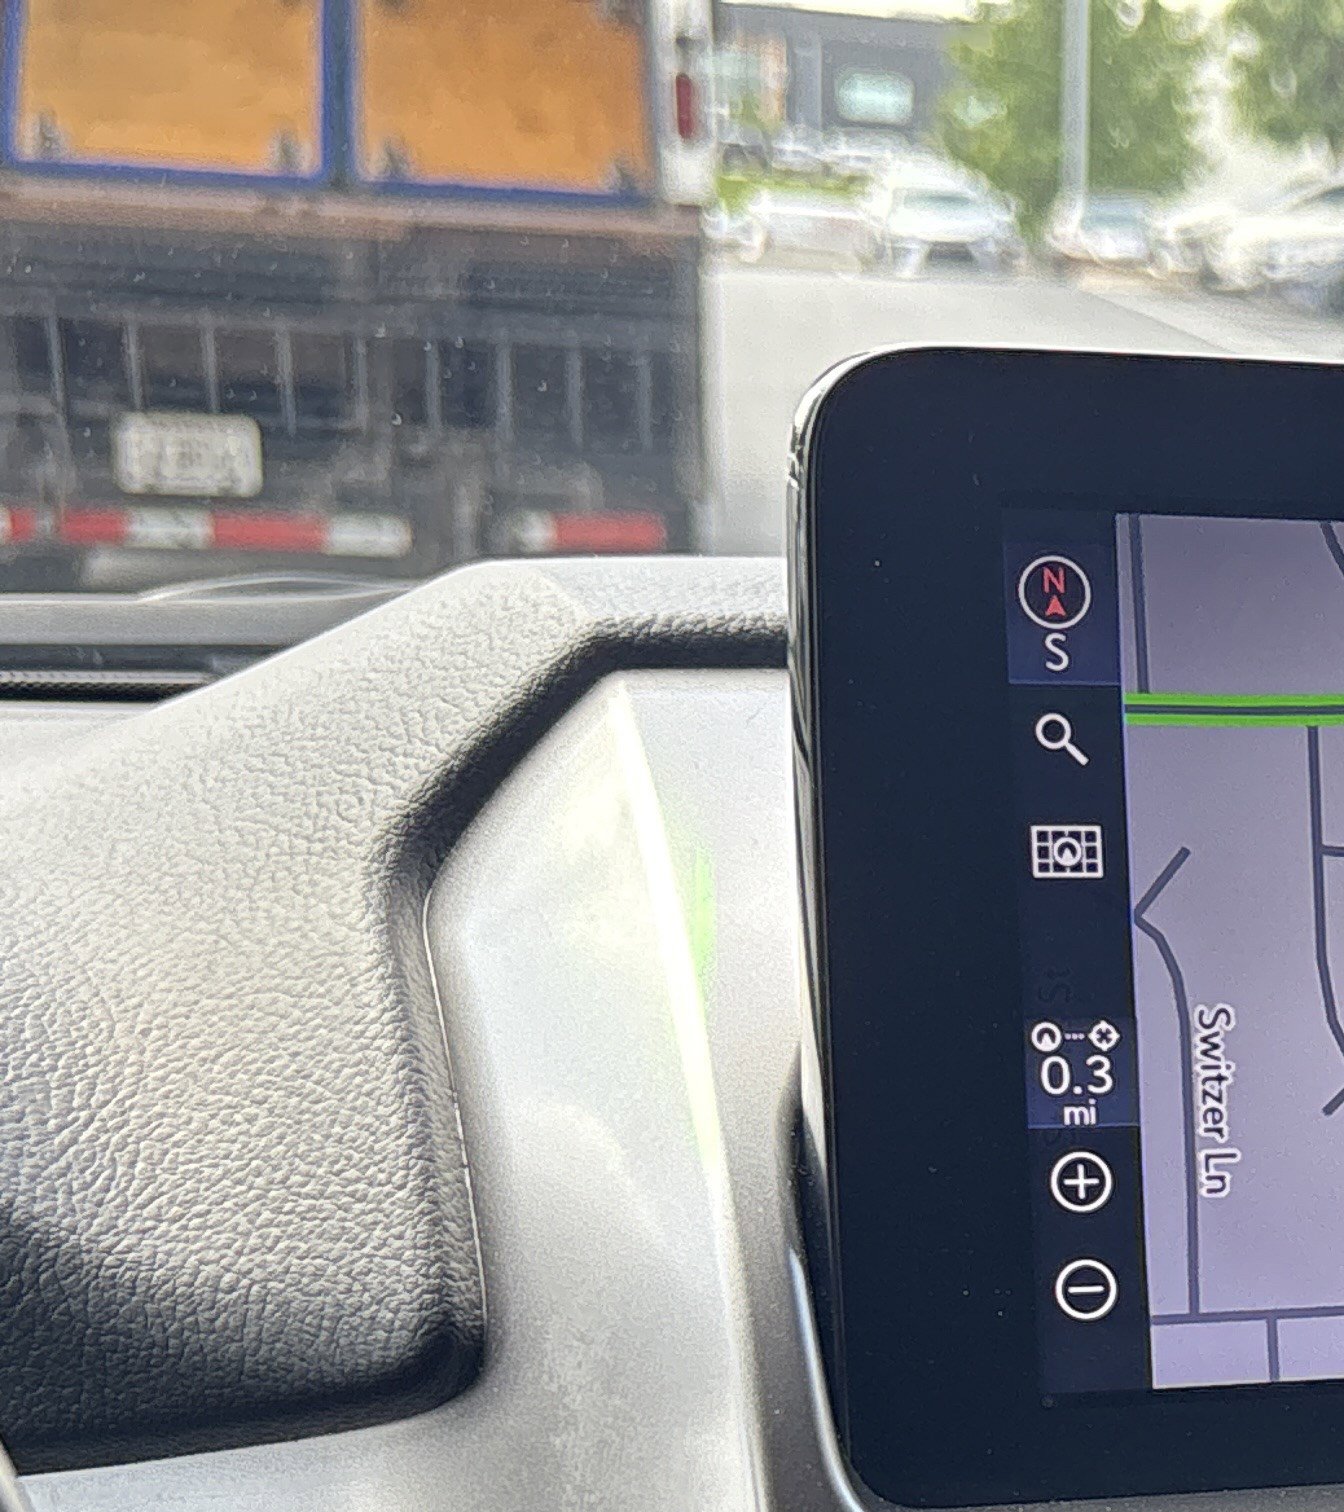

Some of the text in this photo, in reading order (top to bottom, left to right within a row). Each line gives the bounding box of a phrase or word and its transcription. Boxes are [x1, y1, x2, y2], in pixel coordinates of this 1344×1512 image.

[1044, 567, 1066, 593] N
[1043, 633, 1069, 671] S
[1039, 1055, 1114, 1096] 0.3
[1063, 1100, 1097, 1126] mi
[1197, 1005, 1240, 1197] Switzer Ln
